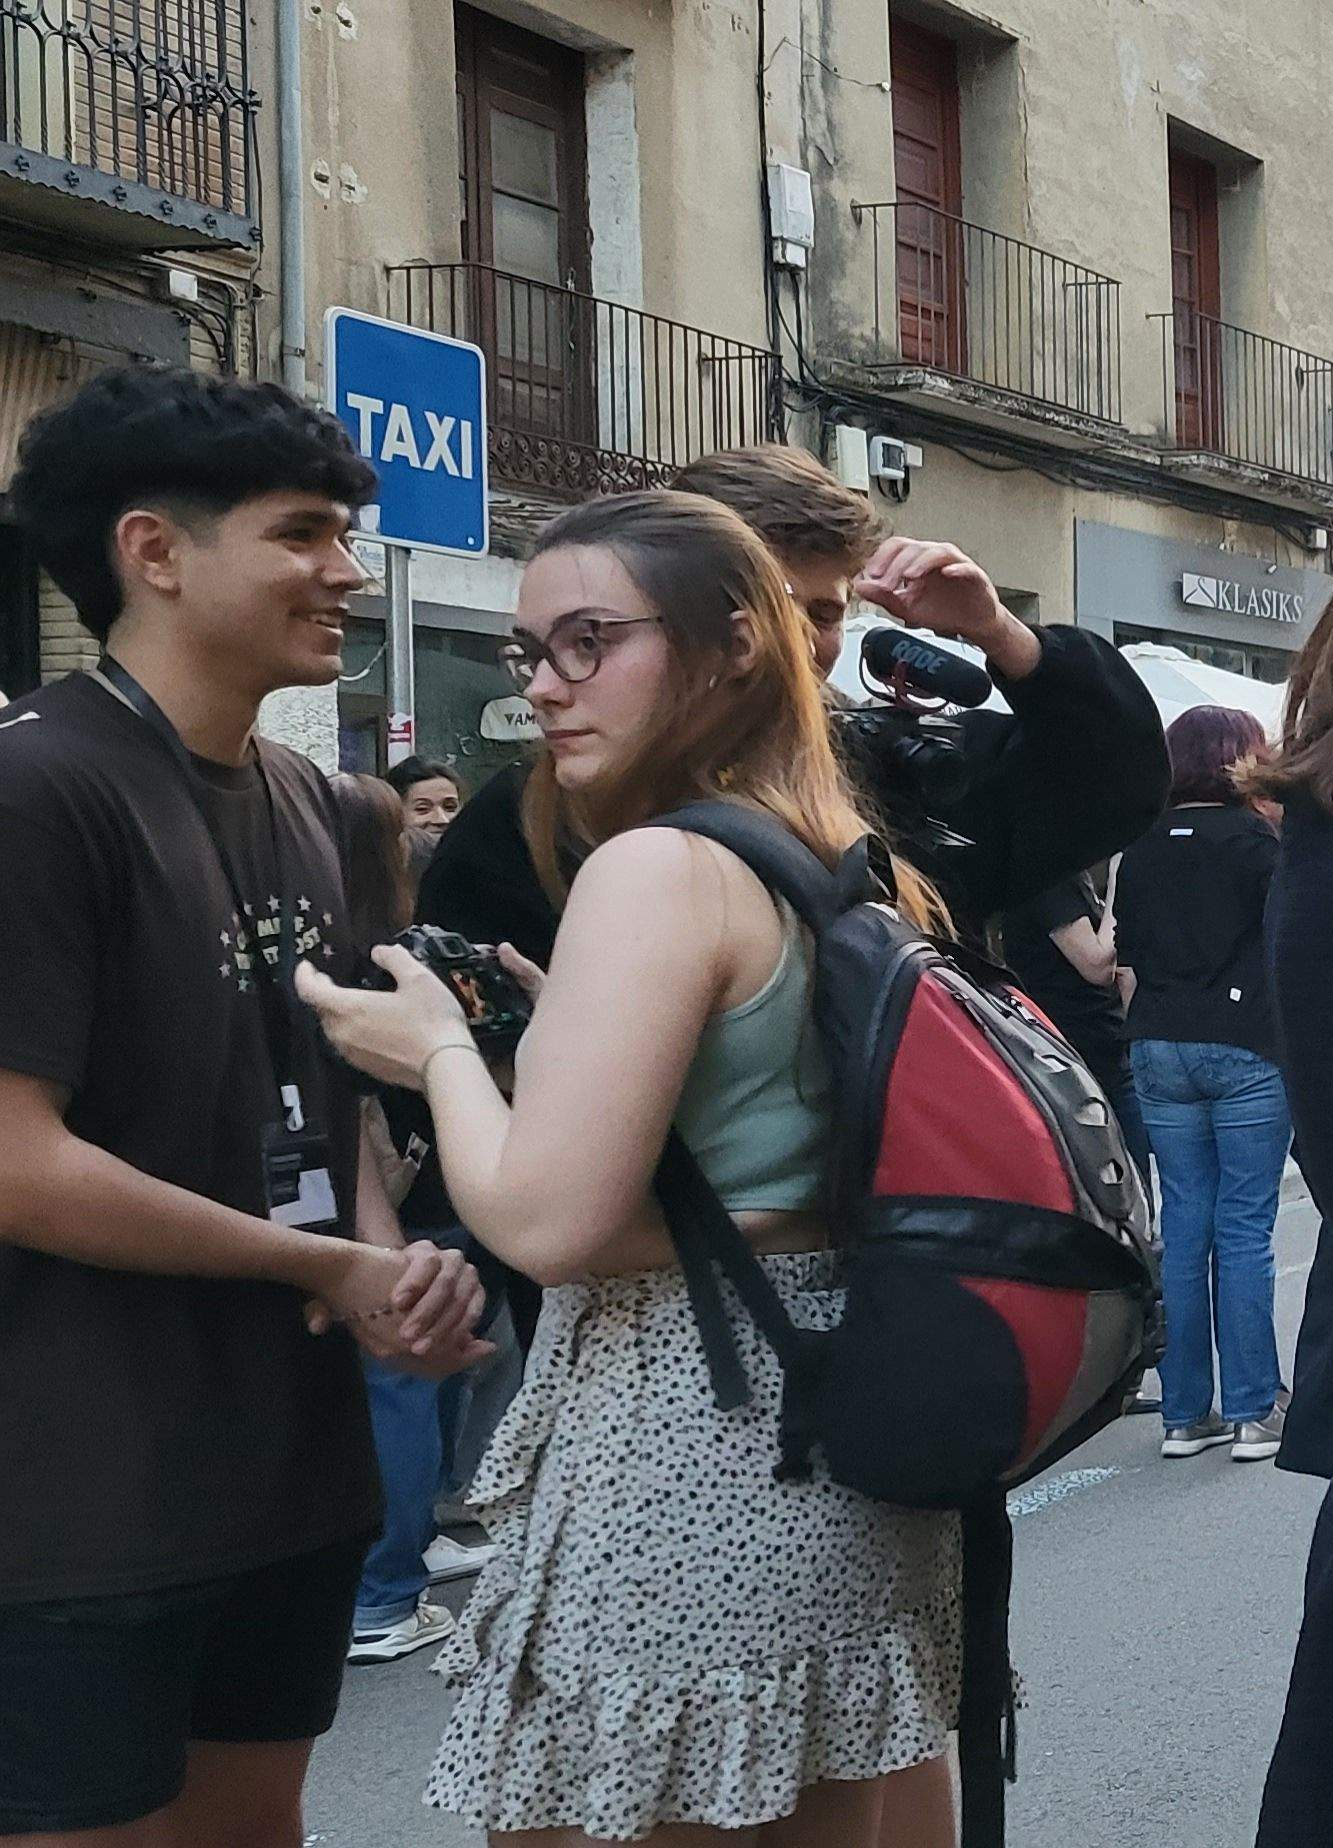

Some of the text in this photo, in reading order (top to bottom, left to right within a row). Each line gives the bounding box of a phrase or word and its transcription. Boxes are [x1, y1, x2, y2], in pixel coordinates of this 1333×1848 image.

[346, 391, 473, 479] TAXI
[1217, 579, 1303, 623] KLASIKS
[504, 712, 540, 726] VAM
